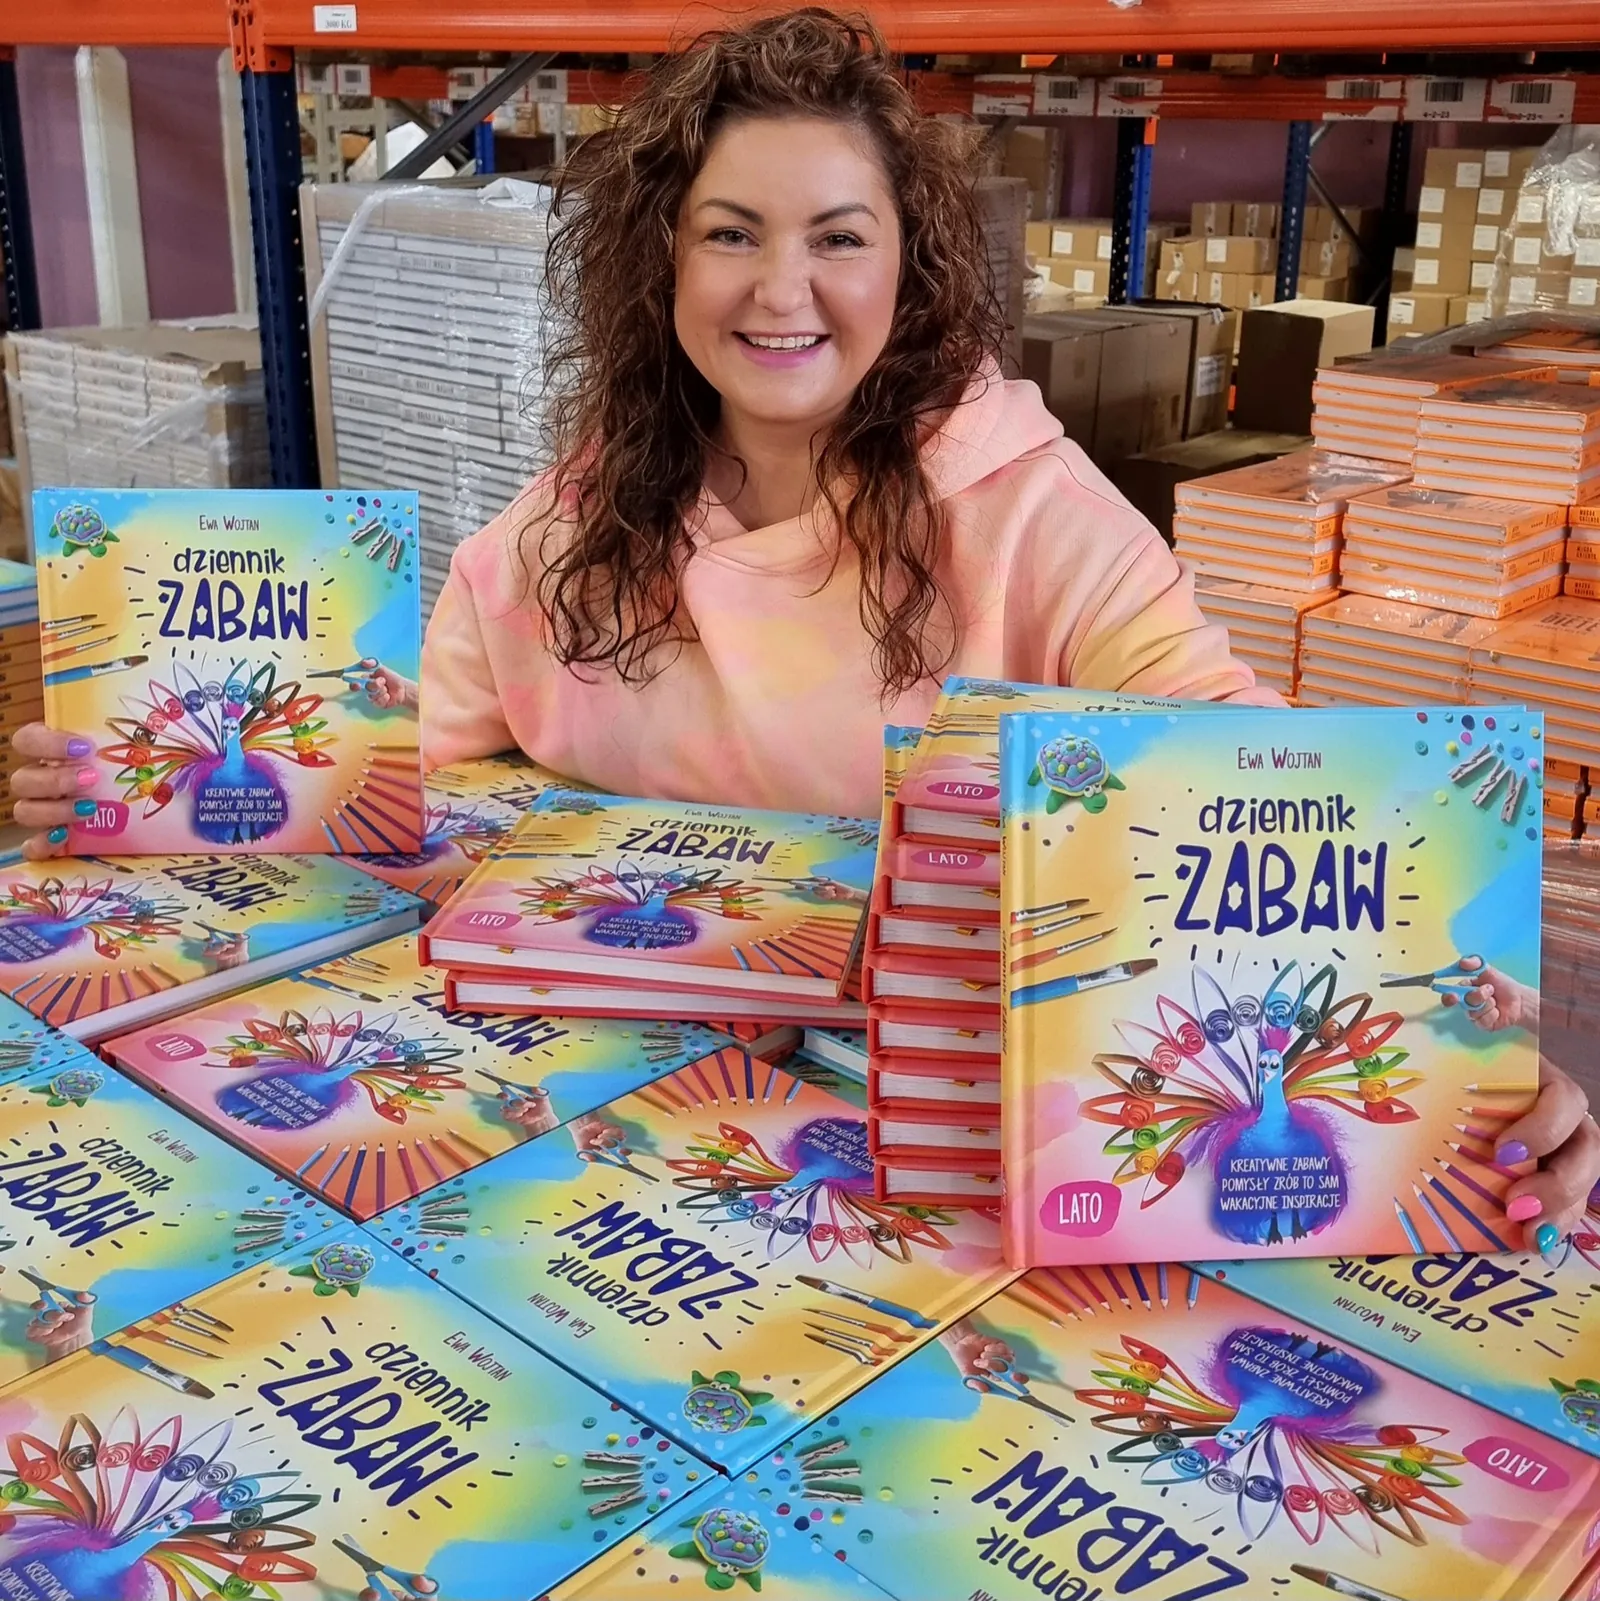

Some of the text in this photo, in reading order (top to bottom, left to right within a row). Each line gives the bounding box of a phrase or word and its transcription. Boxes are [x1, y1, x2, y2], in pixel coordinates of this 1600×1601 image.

[199, 515, 260, 532] EWA WOJTAN
[173, 548, 285, 575] dziennik
[157, 578, 309, 642] ZABAW
[1237, 747, 1322, 771] EWA WOJTAN
[205, 787, 276, 798] KREATYWNE ZABAWY
[256, 800, 265, 810] TO
[267, 799, 283, 810] SAM
[943, 783, 984, 797] LATO
[198, 812, 284, 822] WAKACYJNE INSPIRACJE
[650, 819, 757, 837] dziennik
[1199, 794, 1356, 834] dziennik
[616, 827, 775, 865] ZABAW
[928, 852, 968, 865] LATO
[161, 855, 288, 911] ZABAW
[1173, 839, 1389, 937] ZABAW
[468, 912, 508, 927] LATO
[155, 1036, 195, 1062] LATO
[79, 1137, 174, 1198] dziennik
[1221, 1172, 1340, 1192] POMYSŁY ZRÓB TO SAM
[1230, 1156, 1331, 1173] KREATYWNE ZABAWY
[1058, 1191, 1102, 1223] LATO
[1220, 1193, 1341, 1211] WAKACYJNE INSPIRACJE
[553, 1201, 759, 1320] ZABAW
[546, 1252, 670, 1327] dziennik
[1328, 1256, 1489, 1333] dziennik
[1365, 1253, 1558, 1327] ZAB
[527, 1292, 596, 1339] EWA WOJTAN
[1333, 1295, 1422, 1343] EWA WOJTAN
[443, 1331, 513, 1382] EWA WOJTAN
[1230, 1340, 1353, 1404] POMYSŁY ZRÓB TO SAM
[1238, 1330, 1364, 1395] WAKACYJNE INSPIRACJE
[365, 1341, 491, 1432] dziennik
[1227, 1355, 1334, 1410] KREATYWNE ZABAWY
[257, 1347, 480, 1507] ZABAW
[1487, 1447, 1549, 1485] LATO
[976, 1526, 1103, 1601] ennik
